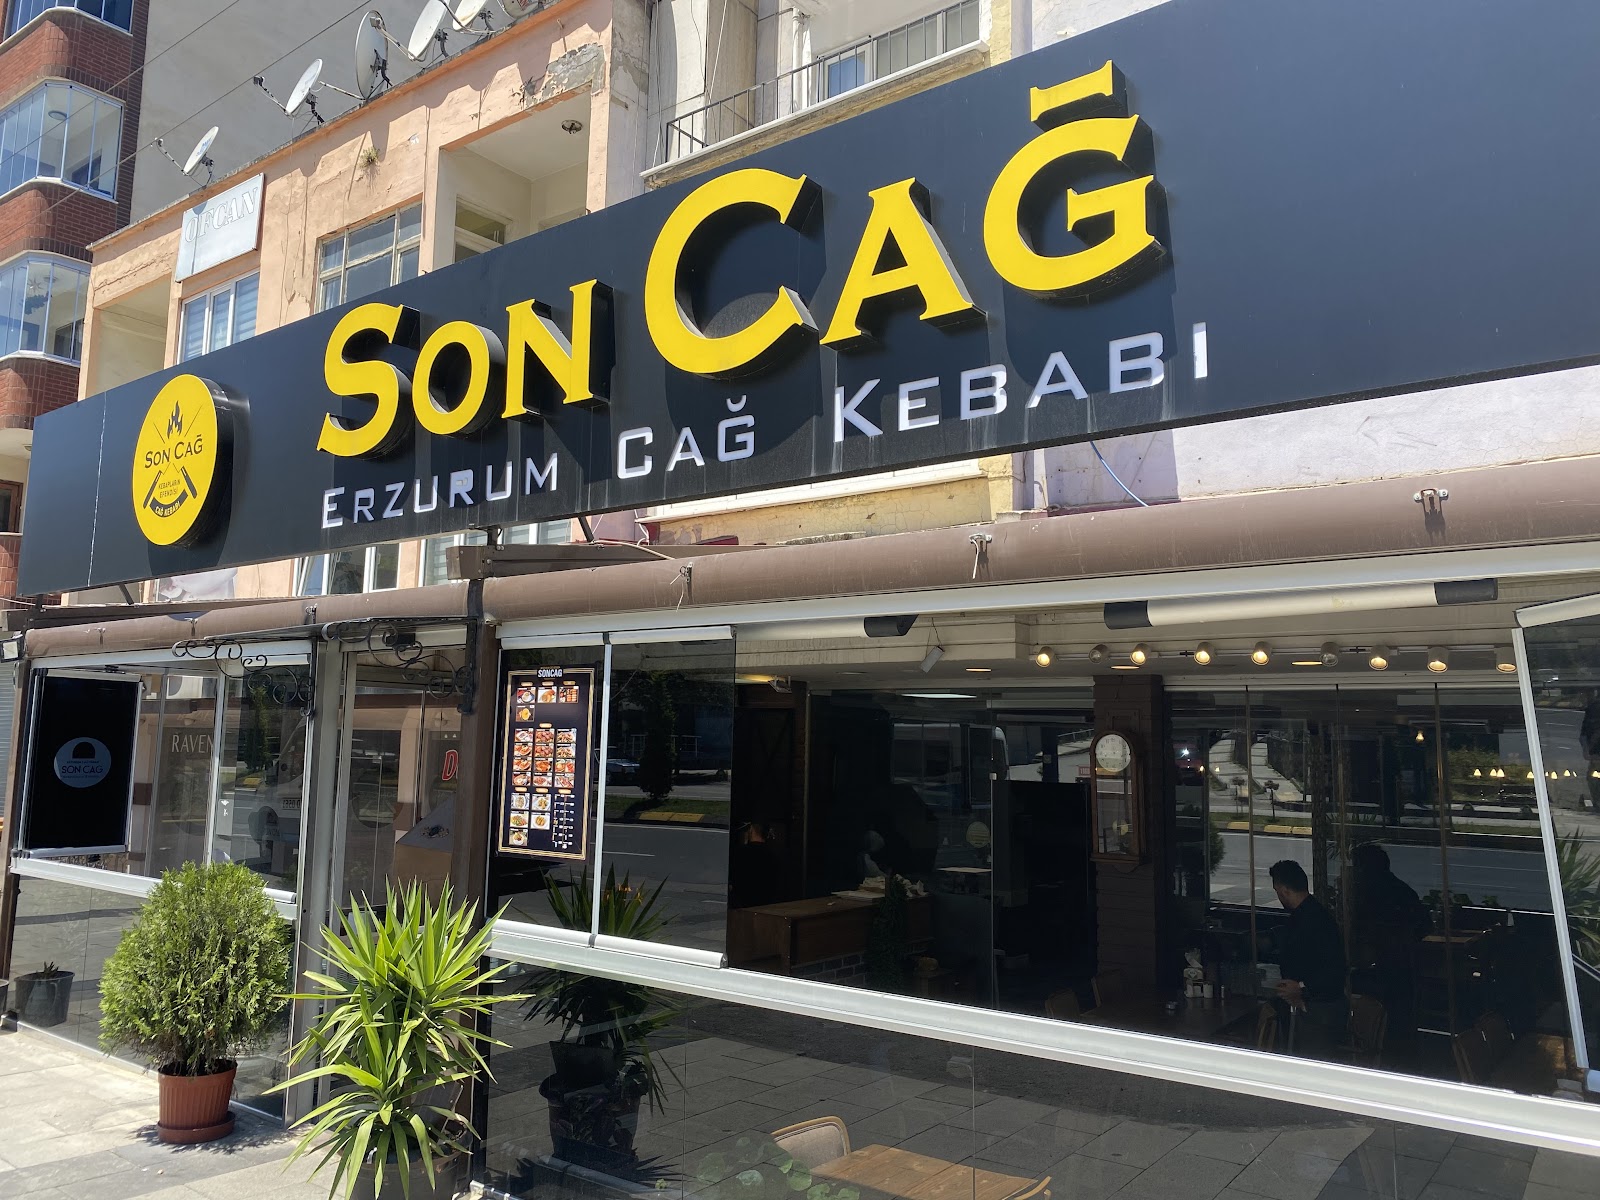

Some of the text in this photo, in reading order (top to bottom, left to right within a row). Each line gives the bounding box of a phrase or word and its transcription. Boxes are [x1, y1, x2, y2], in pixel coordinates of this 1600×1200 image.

[185, 187, 258, 243] OFCAN
[316, 60, 1157, 457] SON CAĞ
[322, 322, 1208, 529] ERZURUM CAĞ KEBABI
[144, 448, 171, 468] SON
[62, 766, 81, 774] SON
